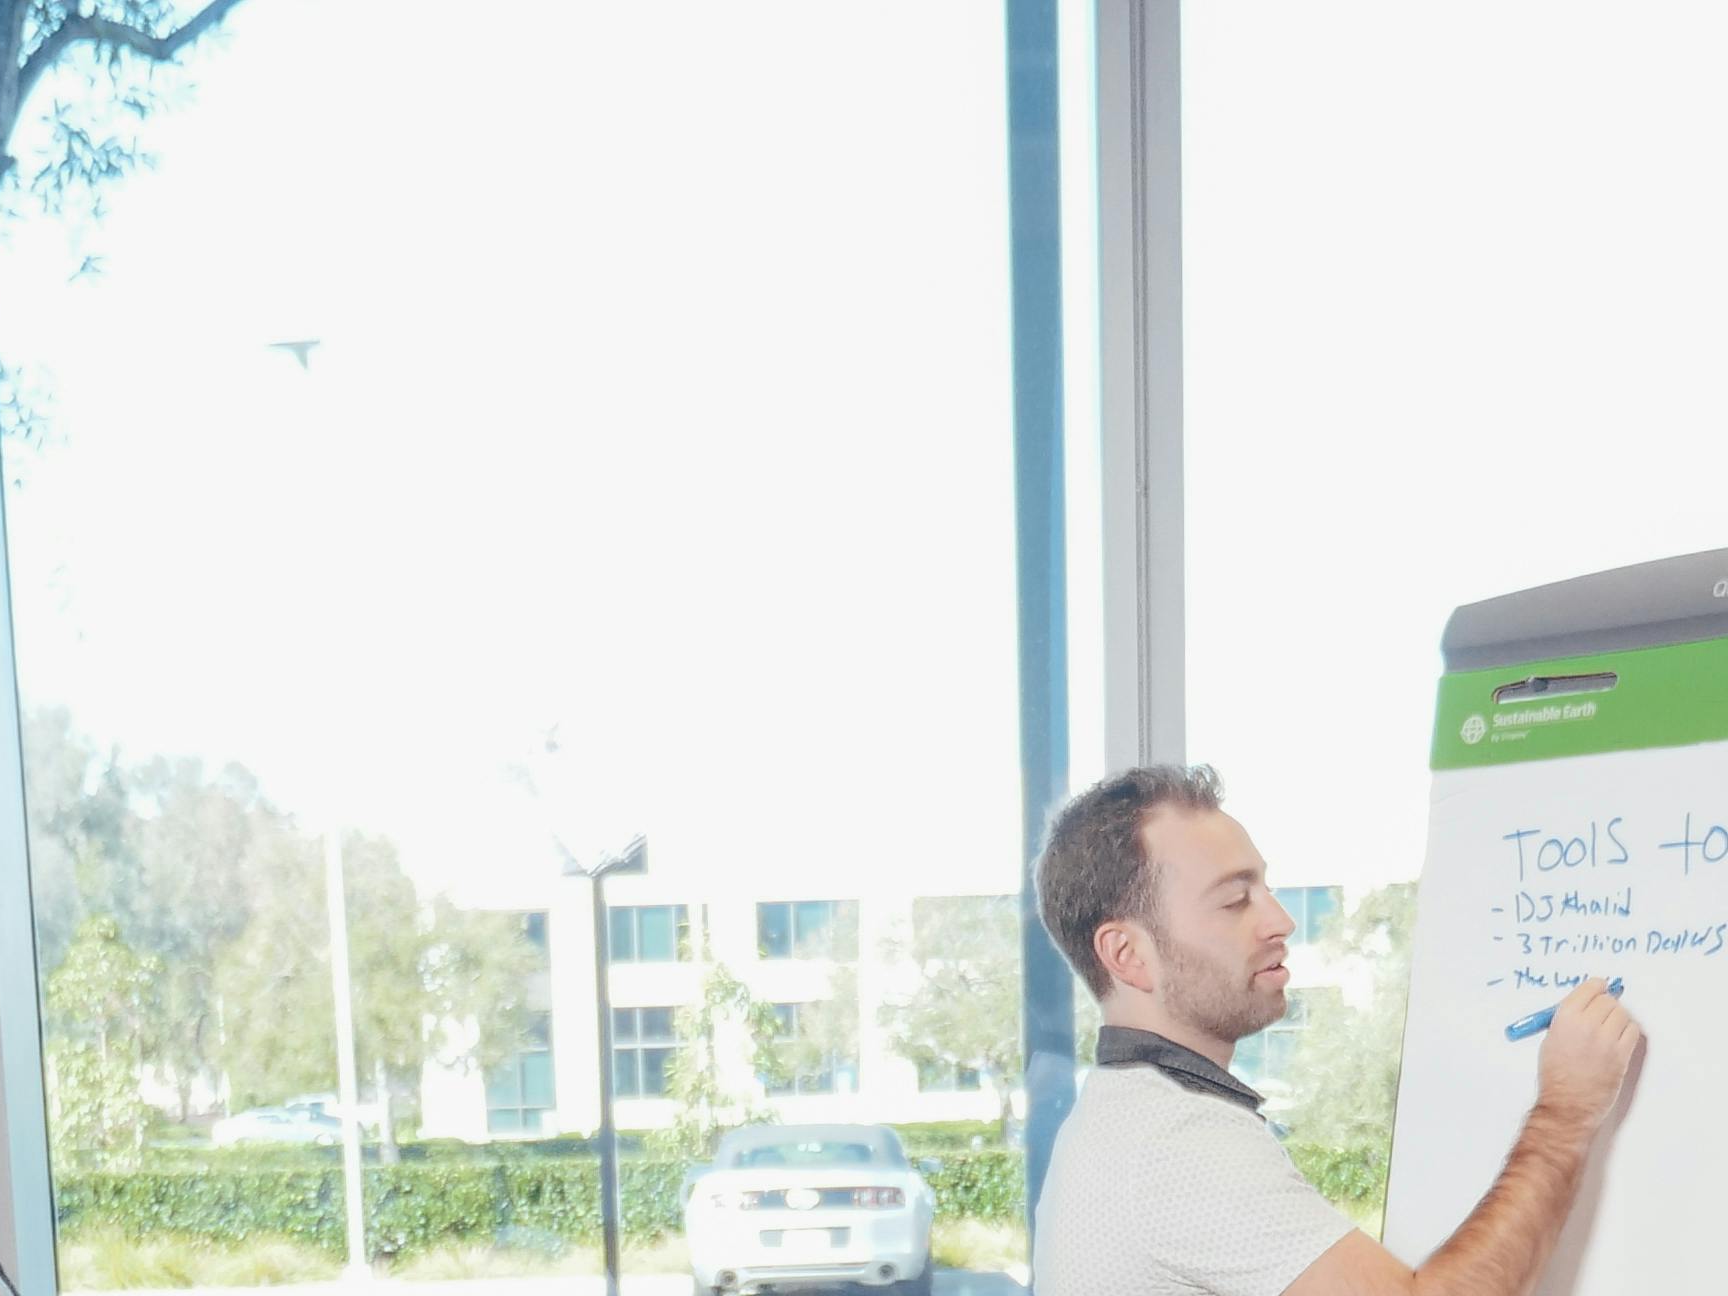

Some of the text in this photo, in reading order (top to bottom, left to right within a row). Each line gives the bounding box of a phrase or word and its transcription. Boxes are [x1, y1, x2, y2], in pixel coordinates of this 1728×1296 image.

[1493, 701, 1598, 727] Sustainable Earth
[1503, 817, 1628, 881] Tools
[1659, 812, 1728, 875] to
[1515, 891, 1553, 923] DJ
[1516, 932, 1532, 954] 3
